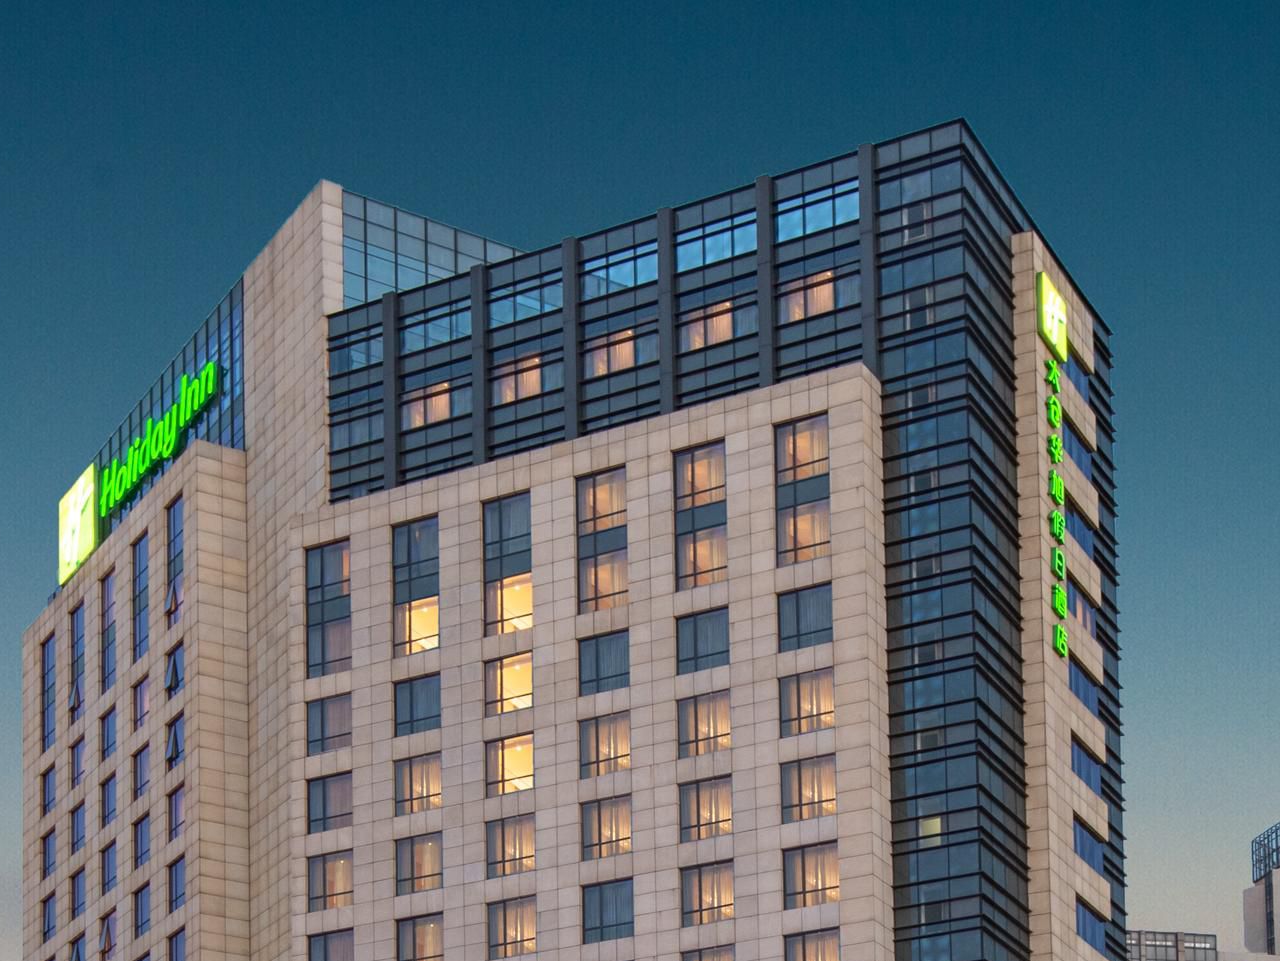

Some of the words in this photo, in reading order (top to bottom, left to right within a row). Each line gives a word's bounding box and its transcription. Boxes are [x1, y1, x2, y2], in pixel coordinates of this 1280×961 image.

[99, 403, 179, 519] Holiday
[178, 360, 218, 428] Inn
[1045, 358, 1068, 658] 太仓华旭假日酒店
